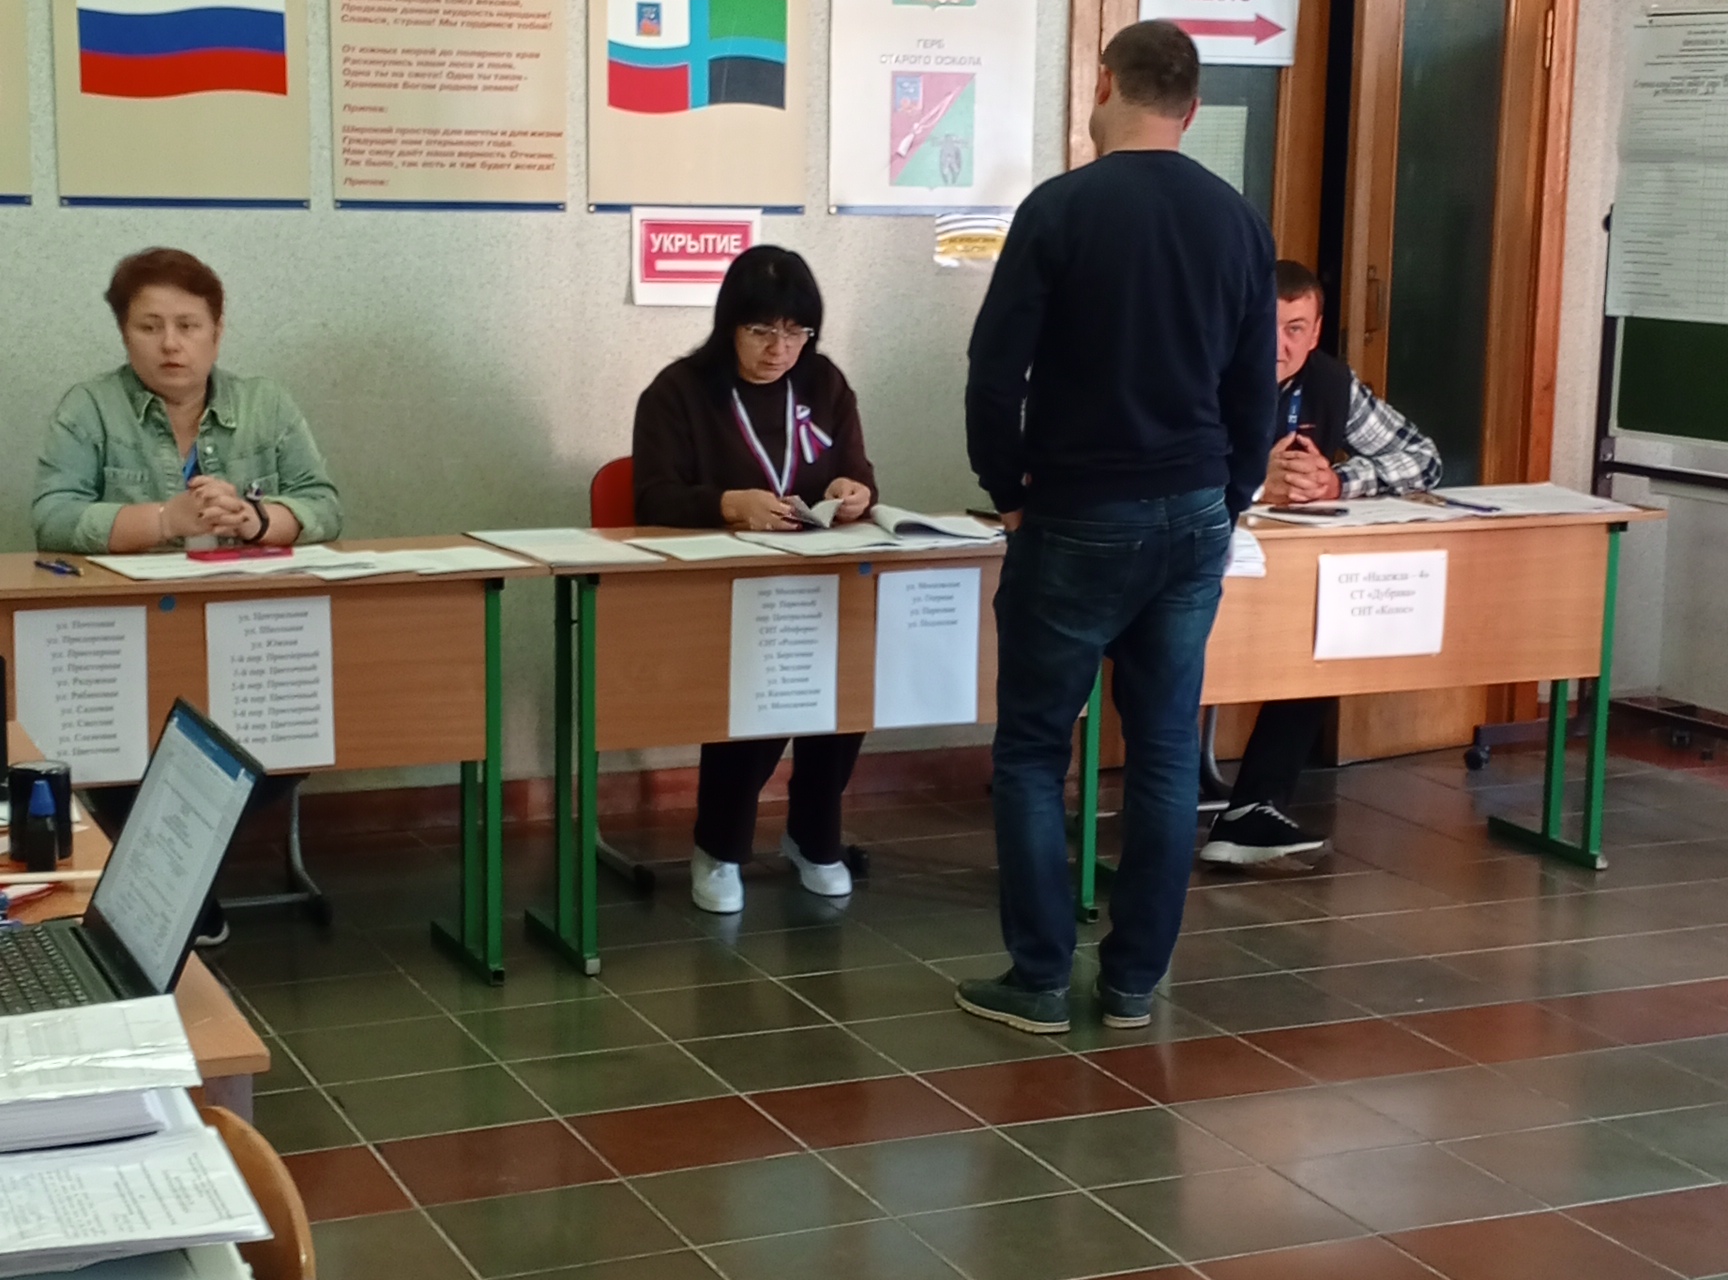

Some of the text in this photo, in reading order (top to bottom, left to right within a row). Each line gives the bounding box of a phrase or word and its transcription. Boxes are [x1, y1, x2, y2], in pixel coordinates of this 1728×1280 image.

[917, 39, 945, 49] ГЕРБ
[880, 54, 982, 66] СТАРОГО ОСКОЛА
[650, 232, 743, 254] УКРЫТИЕ
[1338, 573, 1359, 584] СНТ
[1351, 606, 1374, 617] СНТ
